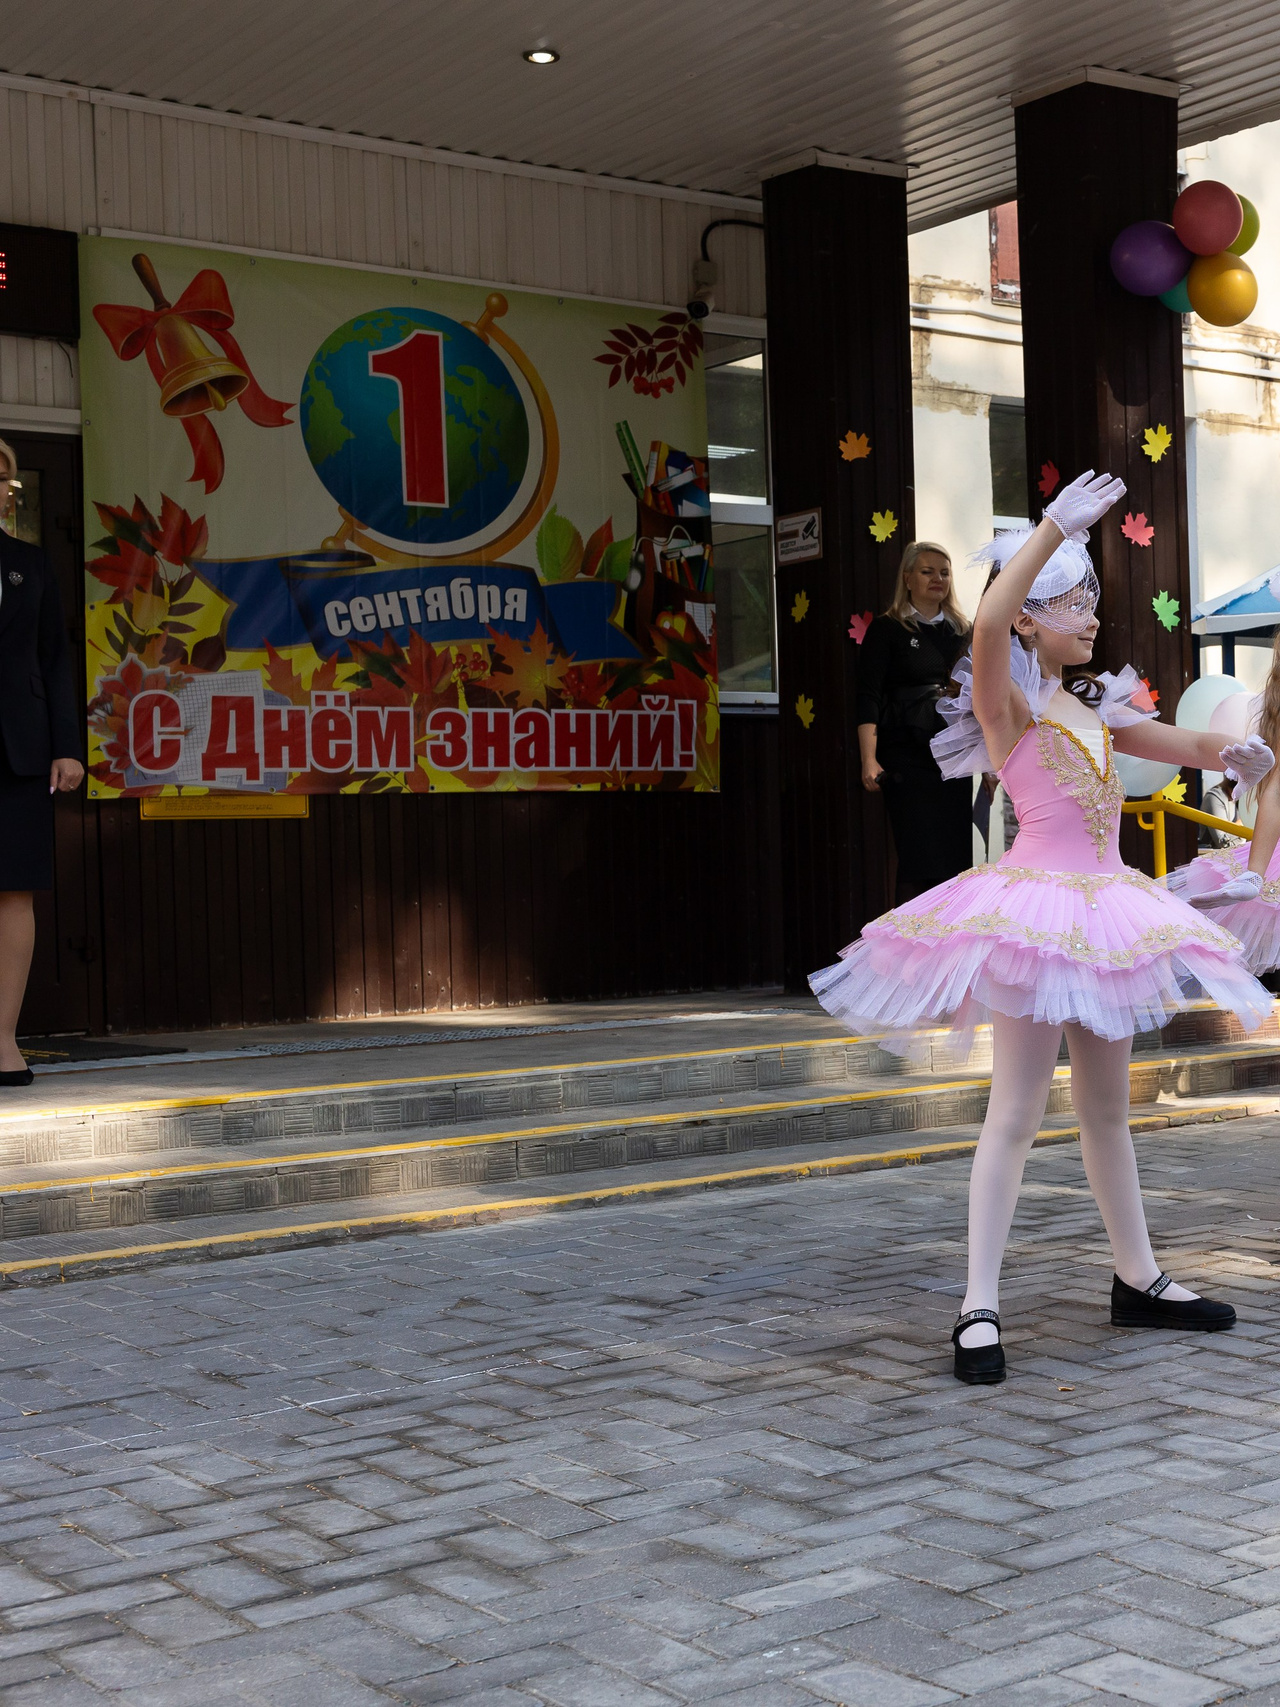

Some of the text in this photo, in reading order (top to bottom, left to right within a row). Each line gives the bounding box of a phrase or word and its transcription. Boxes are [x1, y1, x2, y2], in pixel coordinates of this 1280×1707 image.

[368, 329, 449, 508] 1
[323, 577, 528, 637] сентября
[129, 690, 697, 784] С Днём знаний!
